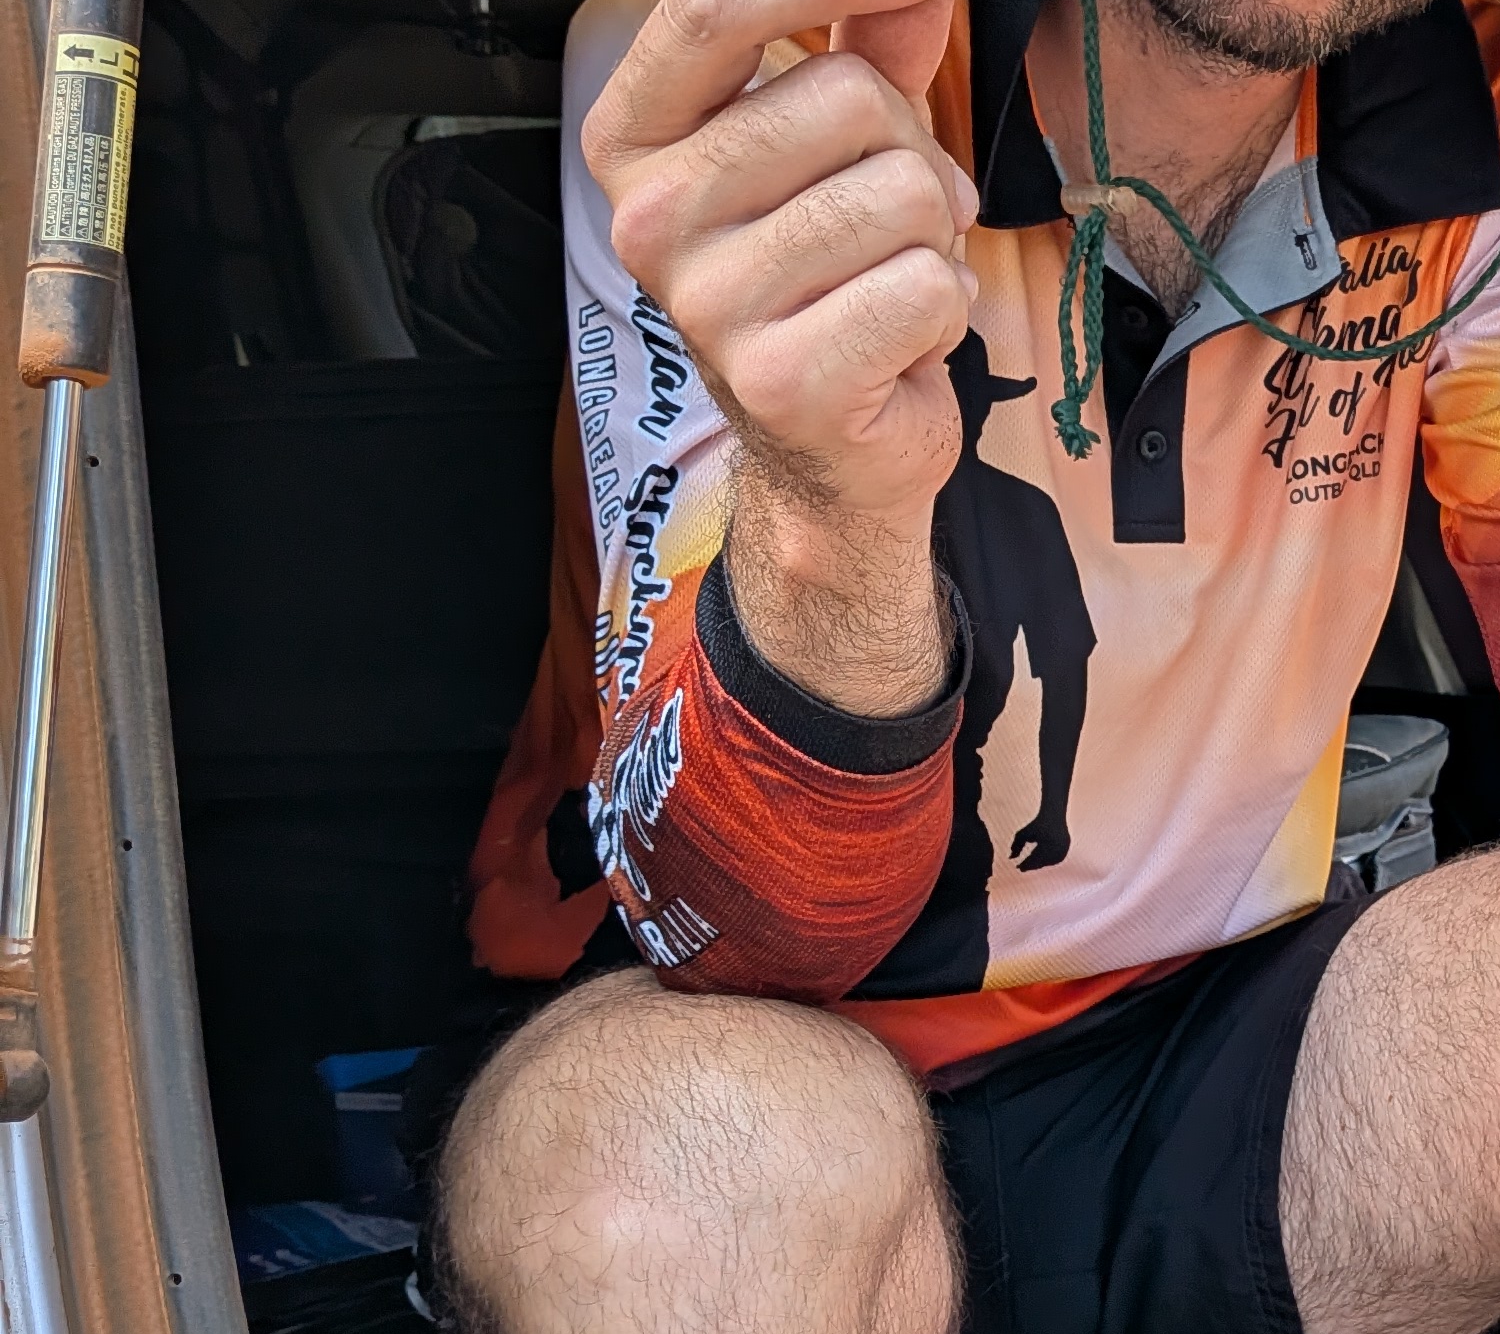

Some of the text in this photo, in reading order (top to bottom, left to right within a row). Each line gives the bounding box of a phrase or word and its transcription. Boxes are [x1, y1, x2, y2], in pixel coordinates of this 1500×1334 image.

[57, 78, 68, 95] GAS
[71, 78, 82, 111] PRESSION
[68, 112, 80, 134] HAUTE
[53, 136, 62, 156] HIGH
[67, 135, 79, 150] GAZ
[66, 150, 77, 161] DU
[112, 161, 122, 210] puncture
[46, 193, 58, 224] CAUTION
[109, 212, 118, 230] not
[107, 233, 116, 247] Do
[1328, 371, 1366, 435] of
